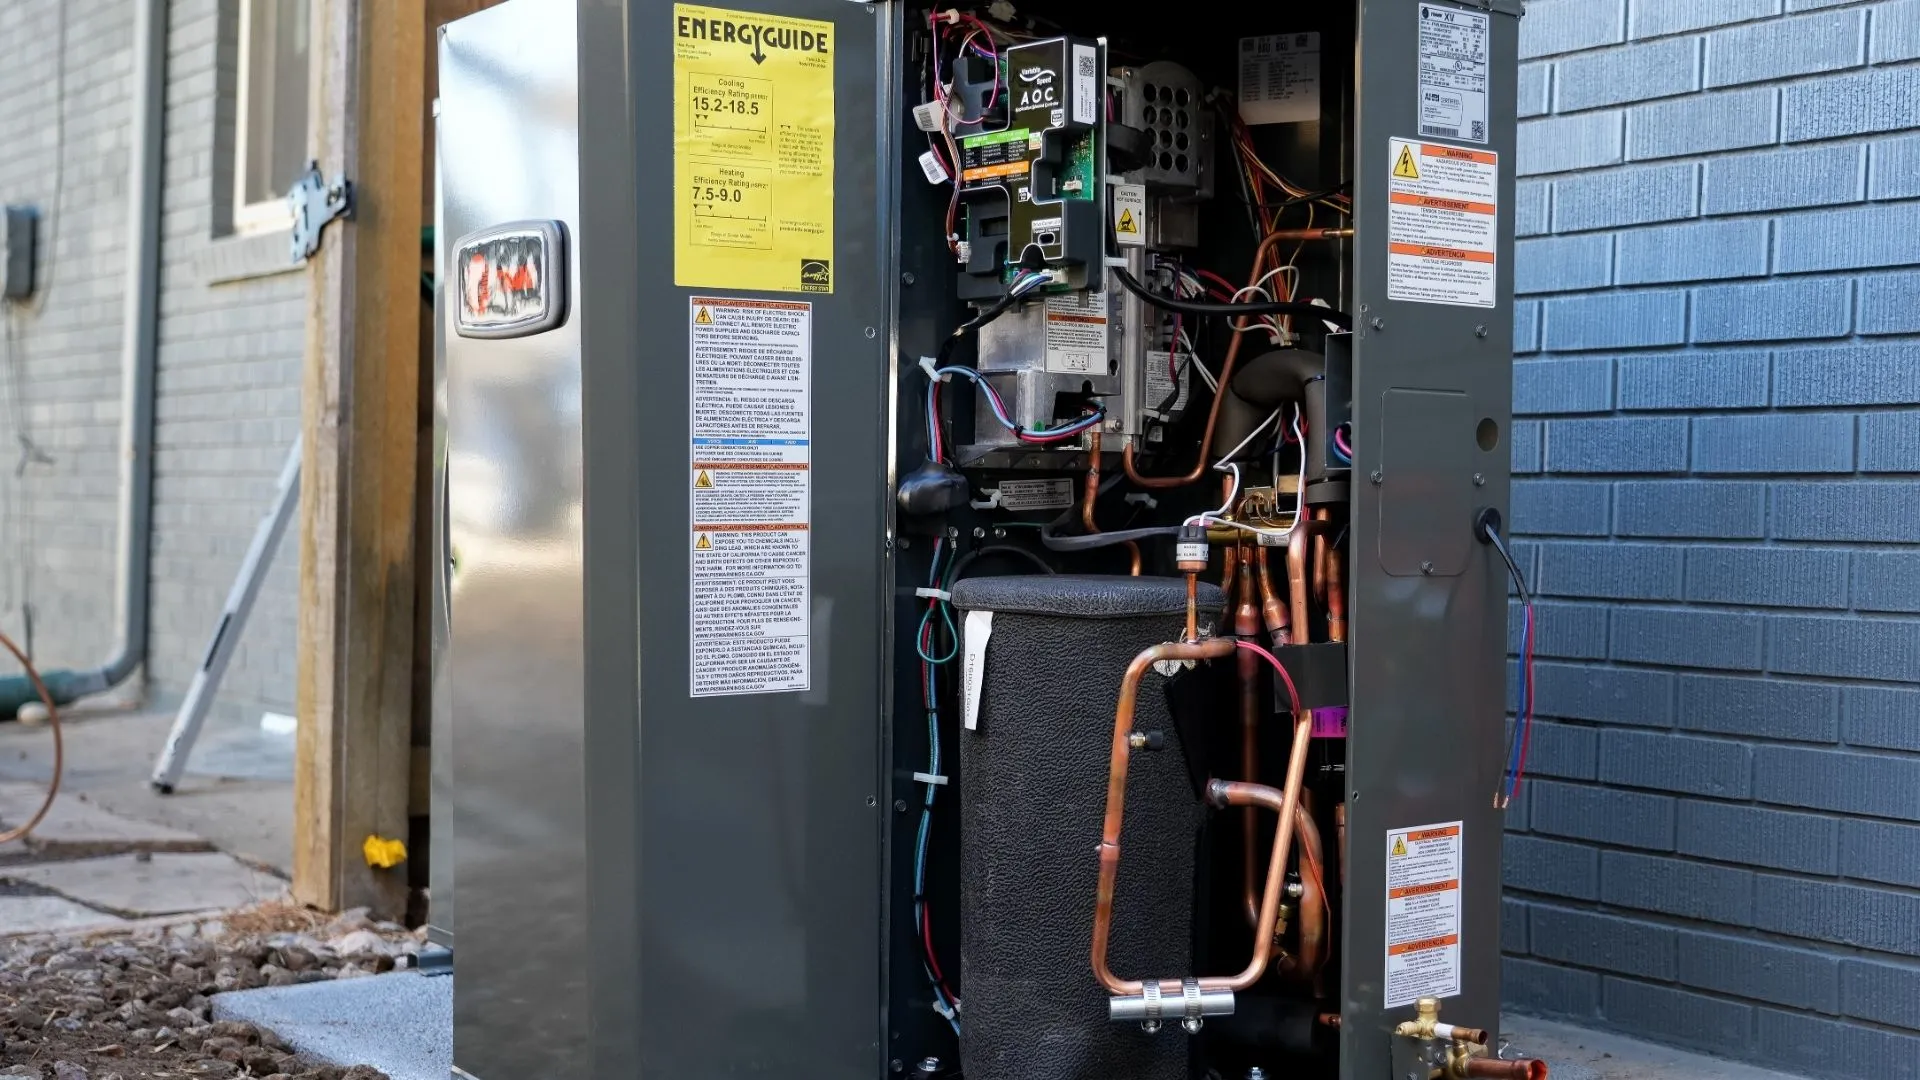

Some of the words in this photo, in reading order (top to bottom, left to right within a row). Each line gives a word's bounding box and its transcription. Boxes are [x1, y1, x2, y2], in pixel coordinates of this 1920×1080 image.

[678, 16, 828, 54] ENERGYGUIDE
[718, 78, 744, 89] Cooling
[693, 86, 725, 97] Efficiency
[728, 89, 749, 99] Rating
[693, 96, 758, 115] 15.2-18.5
[719, 168, 745, 178] Heating
[694, 176, 726, 187] Efficiency
[728, 179, 749, 188] Rating
[692, 186, 741, 202] 7.5-9.0
[1424, 198, 1469, 209] AVERTISSEMENT
[1427, 248, 1465, 258] ADVERTENCIA
